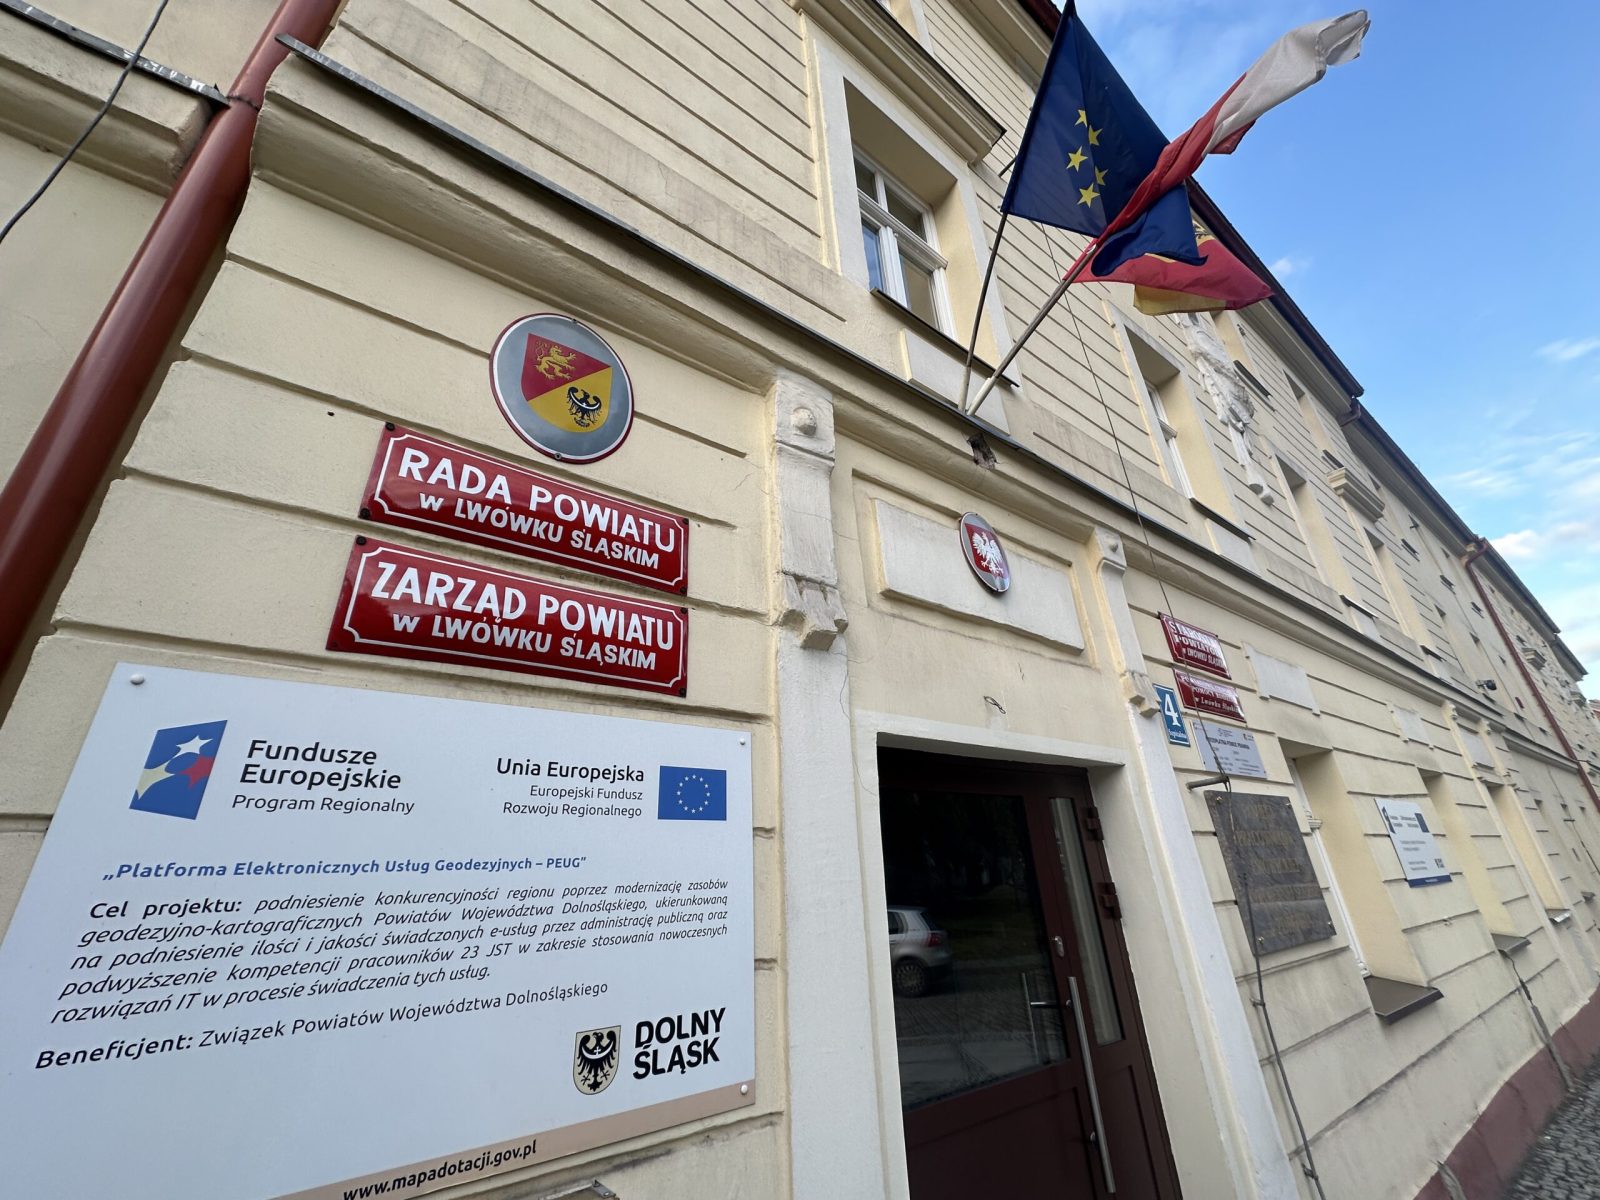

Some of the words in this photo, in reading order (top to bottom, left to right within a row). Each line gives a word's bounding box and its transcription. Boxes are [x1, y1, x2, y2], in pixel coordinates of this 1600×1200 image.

[398, 447, 512, 505] RADA
[530, 484, 675, 552] POWIATU
[454, 498, 563, 542] LWÓWKU
[570, 526, 658, 570] ŚLĄSKIM
[372, 562, 526, 622] ZARZĄD
[538, 595, 674, 649] POWIATU
[432, 616, 552, 653] LWÓWKU
[560, 633, 656, 670] ŚLĄSKIM
[1164, 694, 1180, 726] 4
[247, 740, 377, 765] Fundusze
[496, 758, 540, 776] Unia
[547, 762, 644, 784] Europejska
[240, 764, 402, 791] Europejskie
[530, 785, 594, 800] Europejski
[598, 788, 643, 800] Fundusz
[232, 794, 314, 812] Program
[321, 797, 414, 815] Regionalny
[502, 802, 558, 816] Rozwoju
[562, 804, 642, 818] Regionalnego
[102, 862, 226, 881] „Platforma
[234, 860, 379, 876] Elektronicznych
[386, 860, 430, 874] Usług
[434, 858, 532, 873] Geodezyjnych
[78, 914, 362, 947] geodezyjno-kartograficznych
[374, 909, 450, 925] Powiatów
[462, 902, 554, 922] Województwa
[562, 898, 648, 914] Dolnośląskiego,
[656, 894, 728, 910] ukierunkowaną
[90, 900, 128, 918] Cel
[142, 898, 242, 920] projektu:
[254, 894, 364, 914] podniesienie
[375, 888, 498, 906] konkurencyjności
[506, 886, 554, 902] regionu
[562, 883, 607, 899] poprzez
[614, 880, 682, 896] modernizację
[688, 878, 728, 890] zasobów
[58, 969, 217, 1000] podwyższenie
[227, 958, 341, 984] kompetencji
[348, 949, 454, 972] pracowników
[460, 945, 478, 960] 23
[486, 943, 512, 957] JST
[518, 944, 531, 954] w
[536, 938, 586, 952] zakresie
[592, 932, 654, 947] stosowania
[659, 924, 728, 943] nowoczesnych
[70, 954, 102, 970] na
[109, 943, 243, 970] podniesienie
[251, 938, 300, 957] ilości
[306, 938, 312, 951] i
[314, 934, 376, 954] jakości
[383, 926, 483, 946] świadczonych
[490, 922, 536, 938] e-usług
[542, 921, 574, 936] przez
[580, 914, 654, 930] administrację
[657, 912, 704, 926] publiczną
[708, 911, 728, 920] oraz
[50, 995, 173, 1024] rozwiązań
[176, 992, 198, 1010] IT
[201, 992, 221, 1006] w
[222, 982, 305, 1008] procesie
[308, 969, 409, 995] świadczenia
[414, 967, 446, 984] tych
[449, 964, 490, 981] usług.
[35, 1034, 192, 1069] Beneficjent:
[198, 1021, 286, 1048] Związek
[291, 1008, 384, 1035] Powiatów
[390, 994, 500, 1021] Województwa
[506, 982, 608, 1006] Dolnośląskiego
[634, 1007, 726, 1048] DOLNY
[632, 1036, 720, 1079] ŚLĄSK
[343, 1140, 536, 1200] www.mapadotacji.gov.pl
